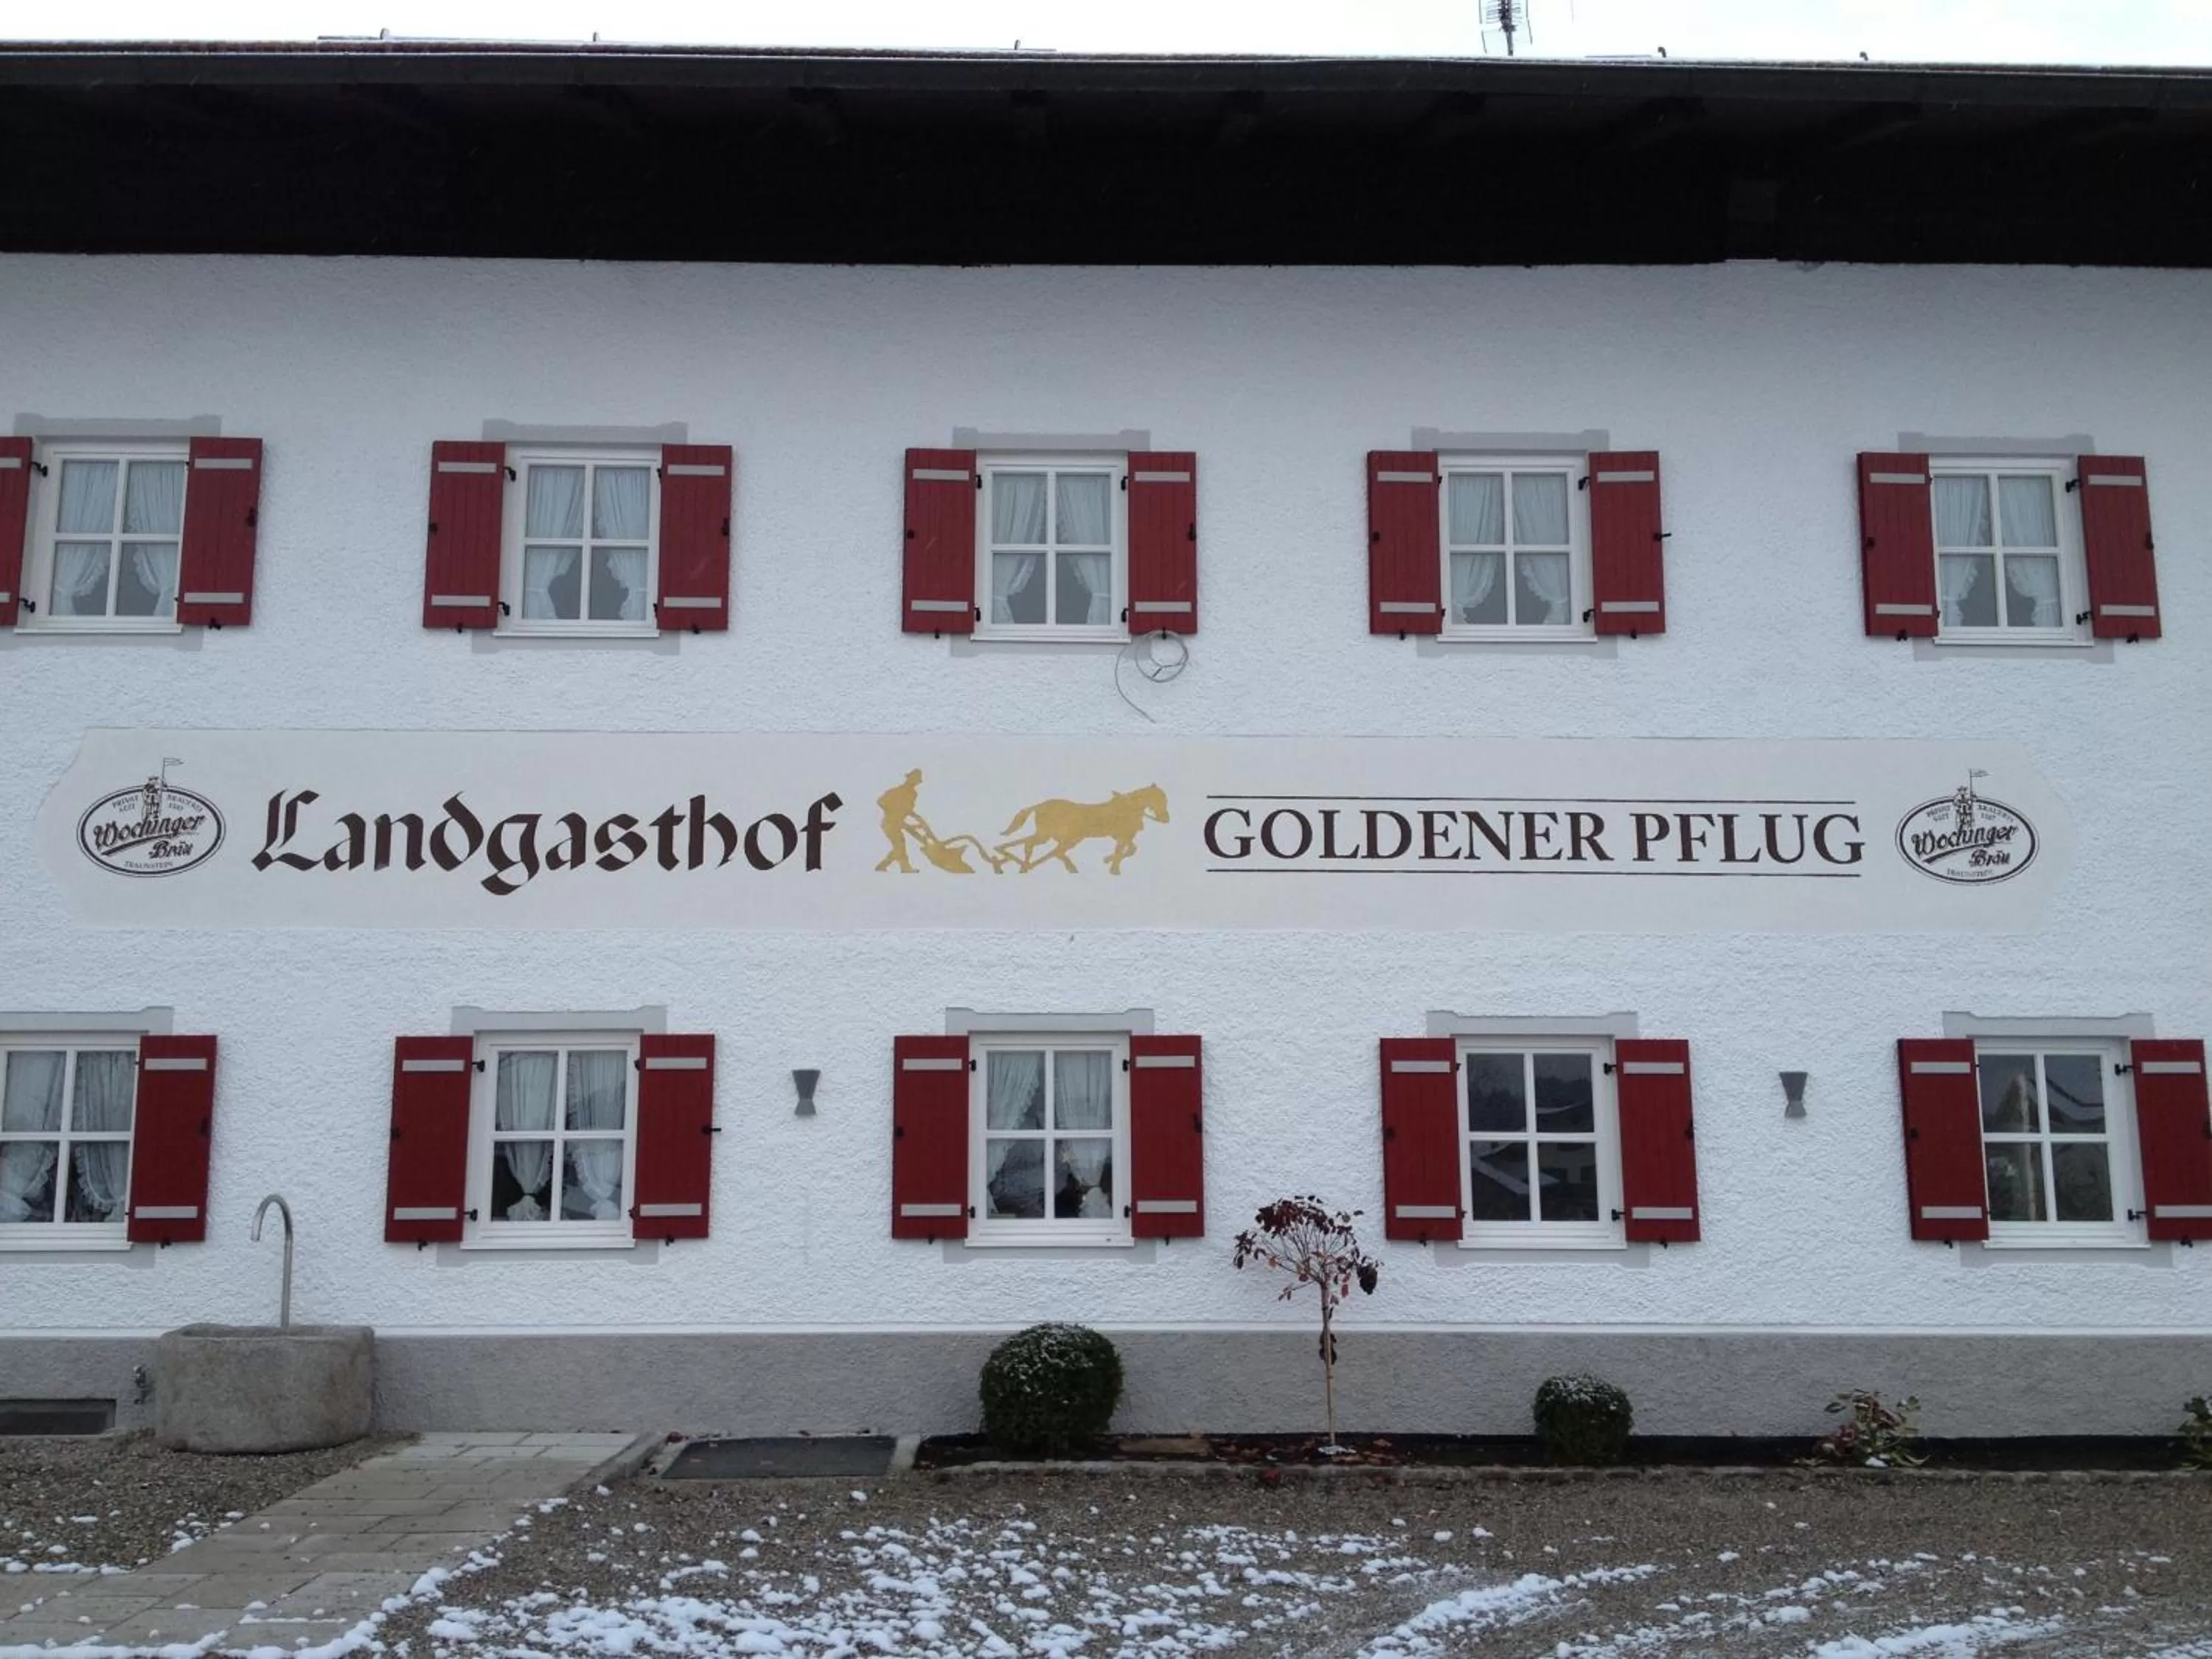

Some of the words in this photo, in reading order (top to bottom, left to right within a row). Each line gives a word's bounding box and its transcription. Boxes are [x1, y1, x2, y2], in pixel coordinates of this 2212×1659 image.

[251, 789, 844, 896] Landgasthof
[1204, 808, 1615, 861] GOLDENER
[1629, 813, 1865, 865] PFLUG
